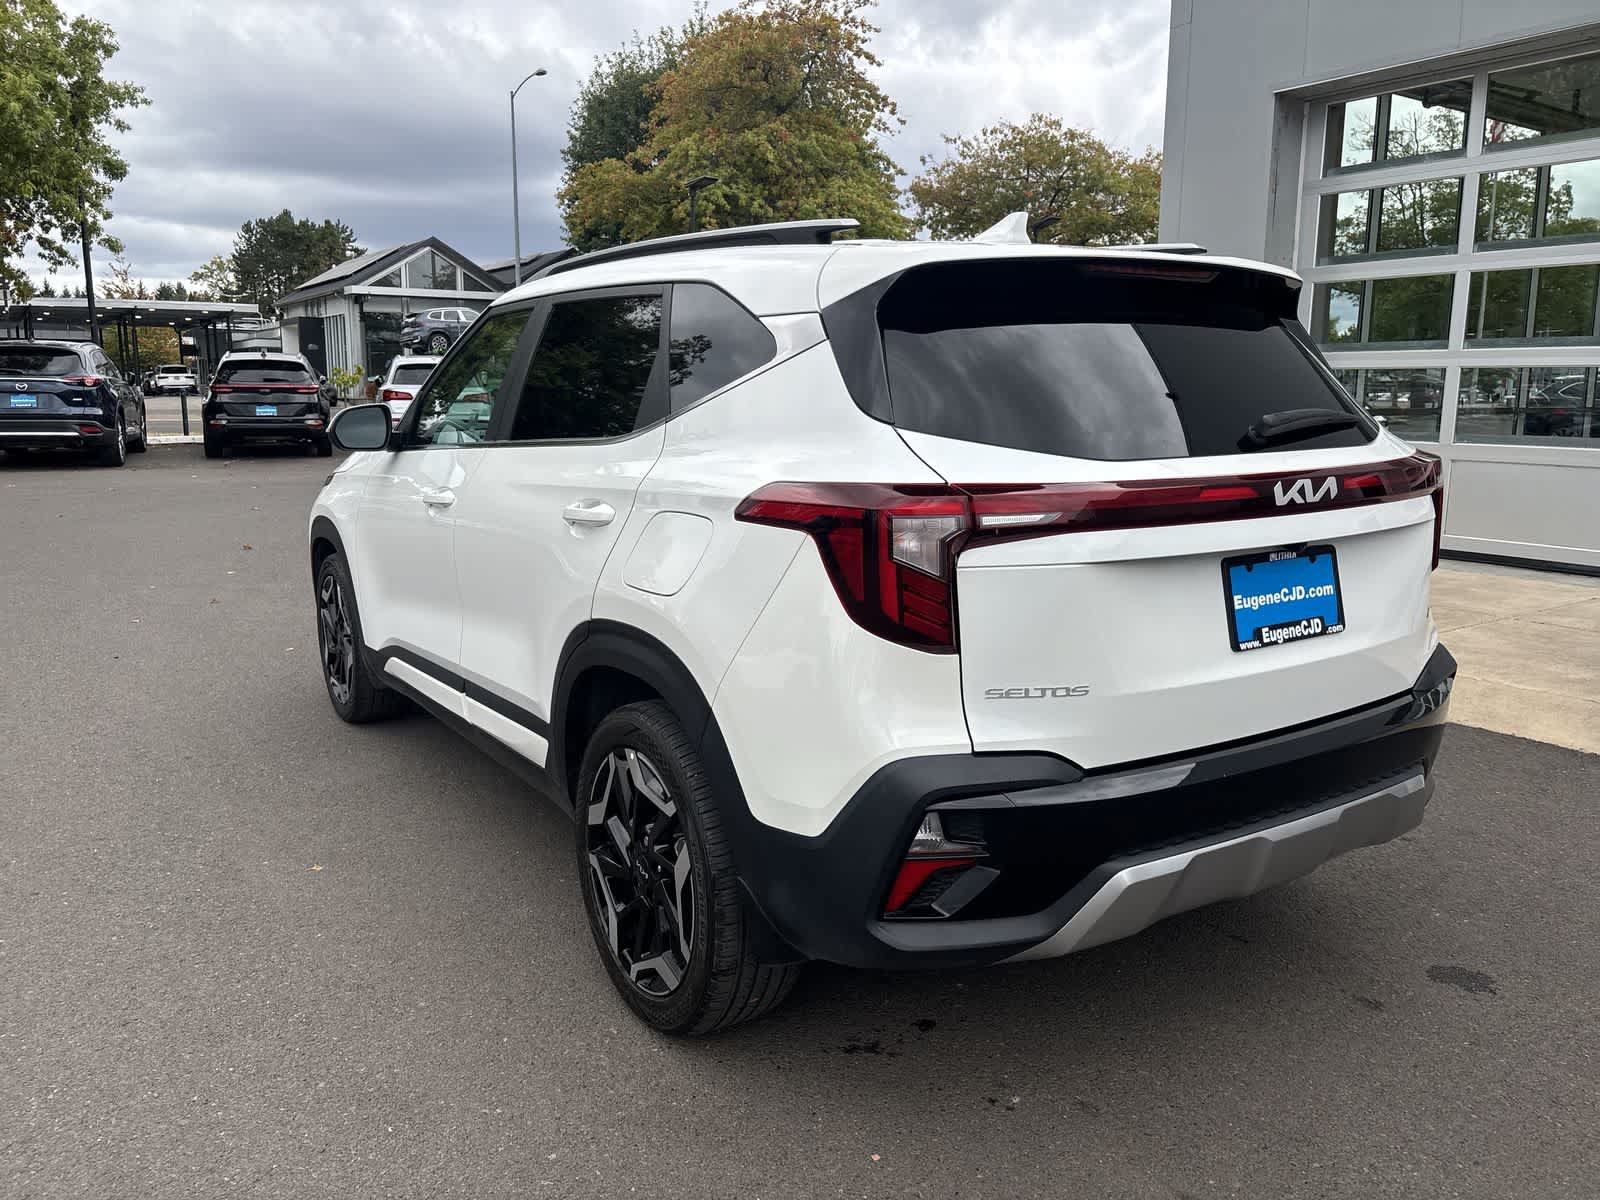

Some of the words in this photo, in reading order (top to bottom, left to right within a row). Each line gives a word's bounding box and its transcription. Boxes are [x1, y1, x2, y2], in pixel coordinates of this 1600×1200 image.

[1273, 476, 1338, 506] KIA
[1233, 584, 1334, 609] EugeneCJD.com
[984, 685, 1090, 700] SELTOS
